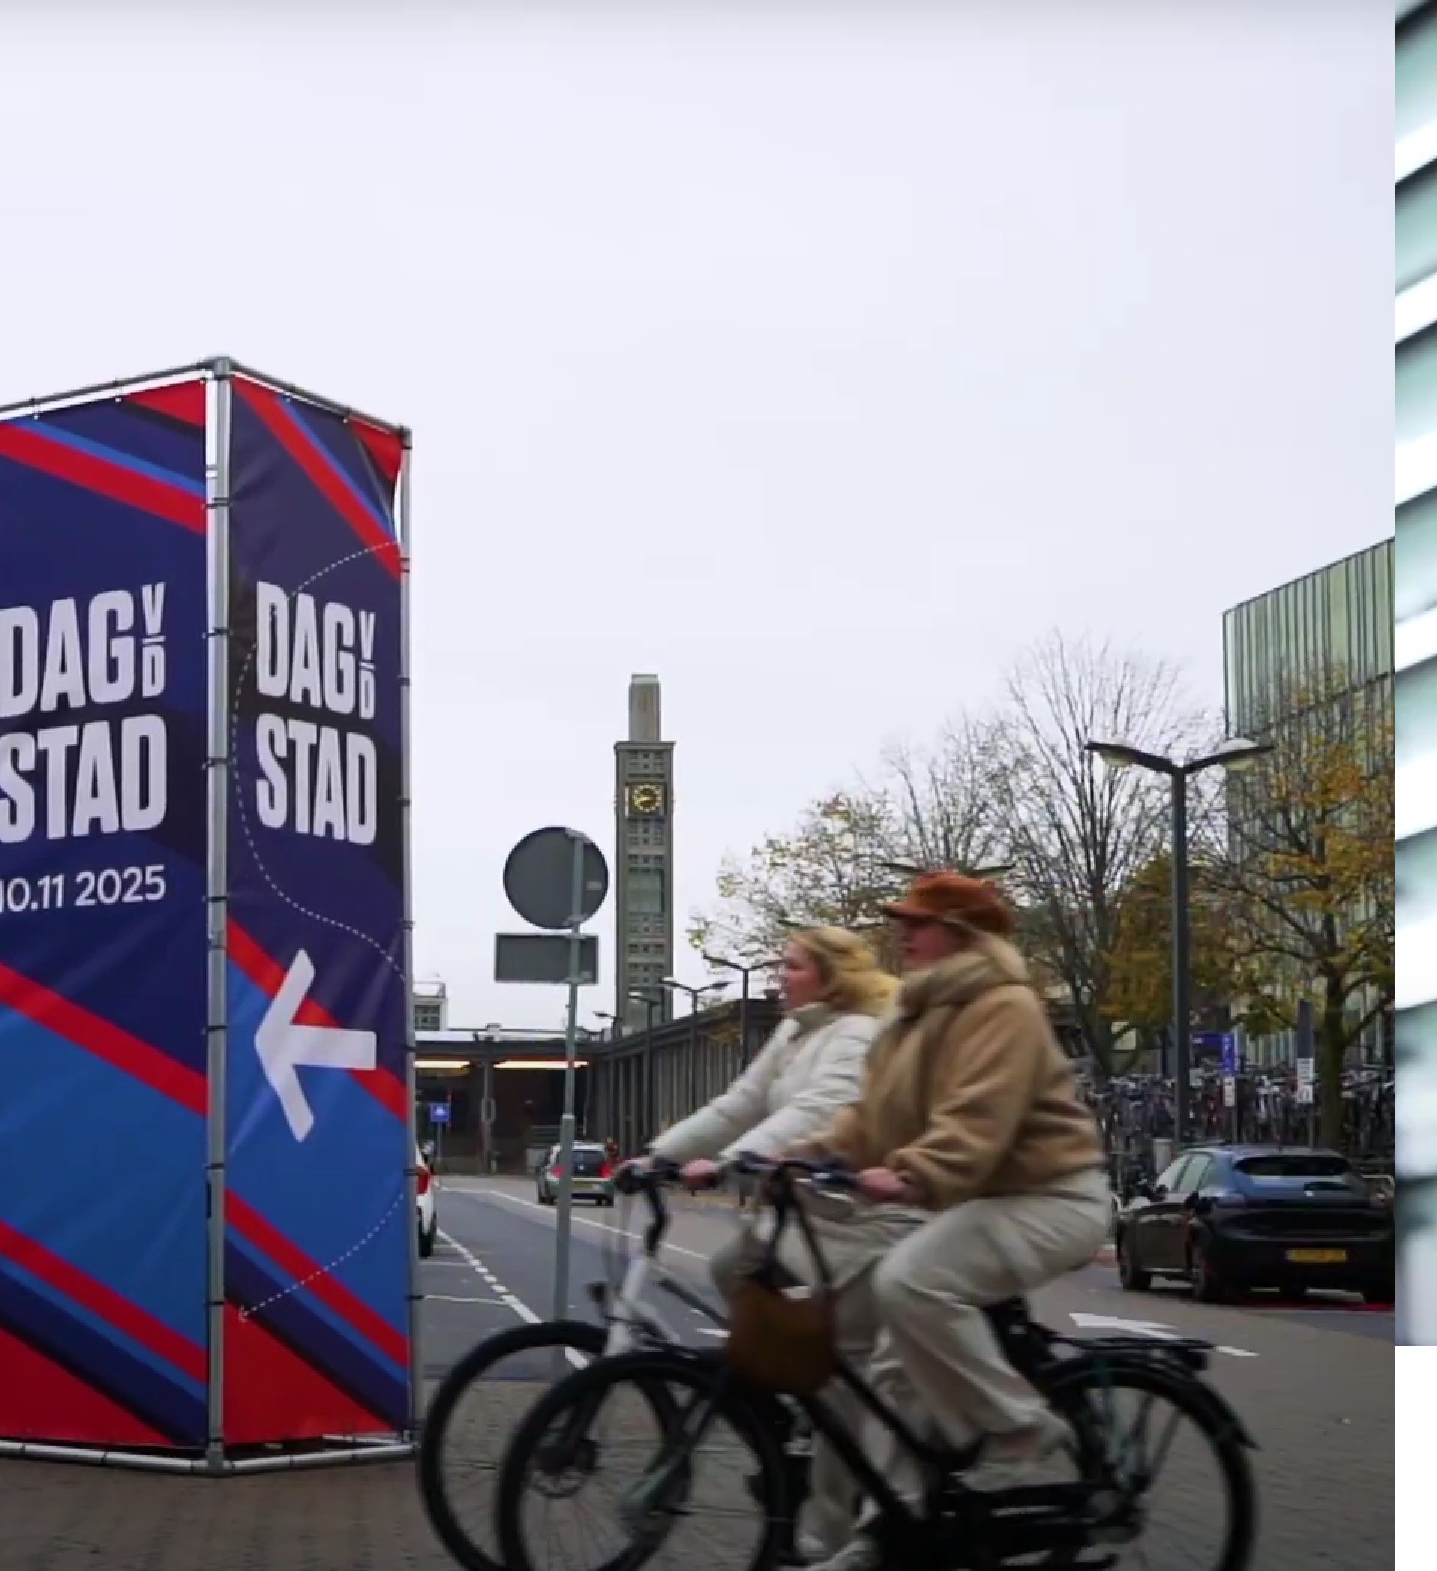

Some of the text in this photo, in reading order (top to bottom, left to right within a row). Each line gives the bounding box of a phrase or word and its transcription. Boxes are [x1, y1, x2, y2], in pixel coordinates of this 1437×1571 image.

[256, 580, 356, 715] DAG
[256, 713, 377, 846] STAD
[74, 865, 166, 906] 2025
